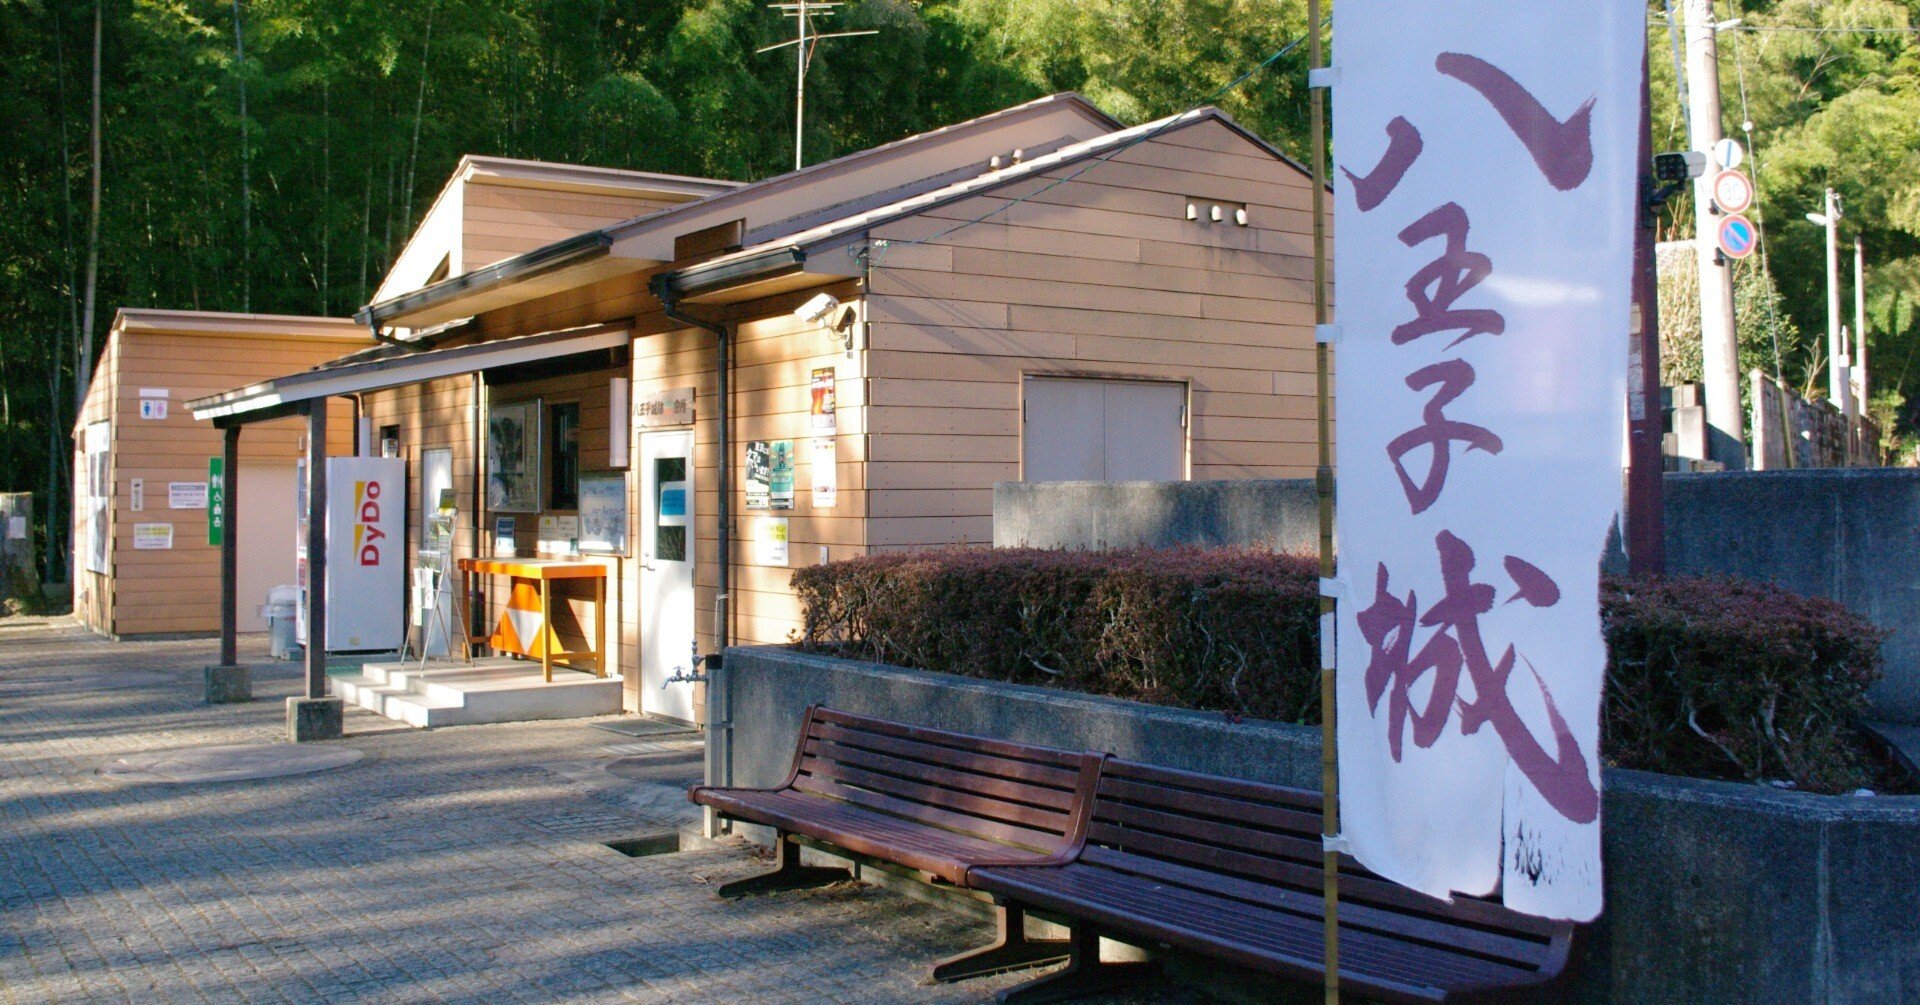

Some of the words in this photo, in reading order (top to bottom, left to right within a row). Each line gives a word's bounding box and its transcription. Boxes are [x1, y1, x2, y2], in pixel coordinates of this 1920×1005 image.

[361, 480, 386, 566] DyDo
[1340, 52, 1600, 824] 八王子城
